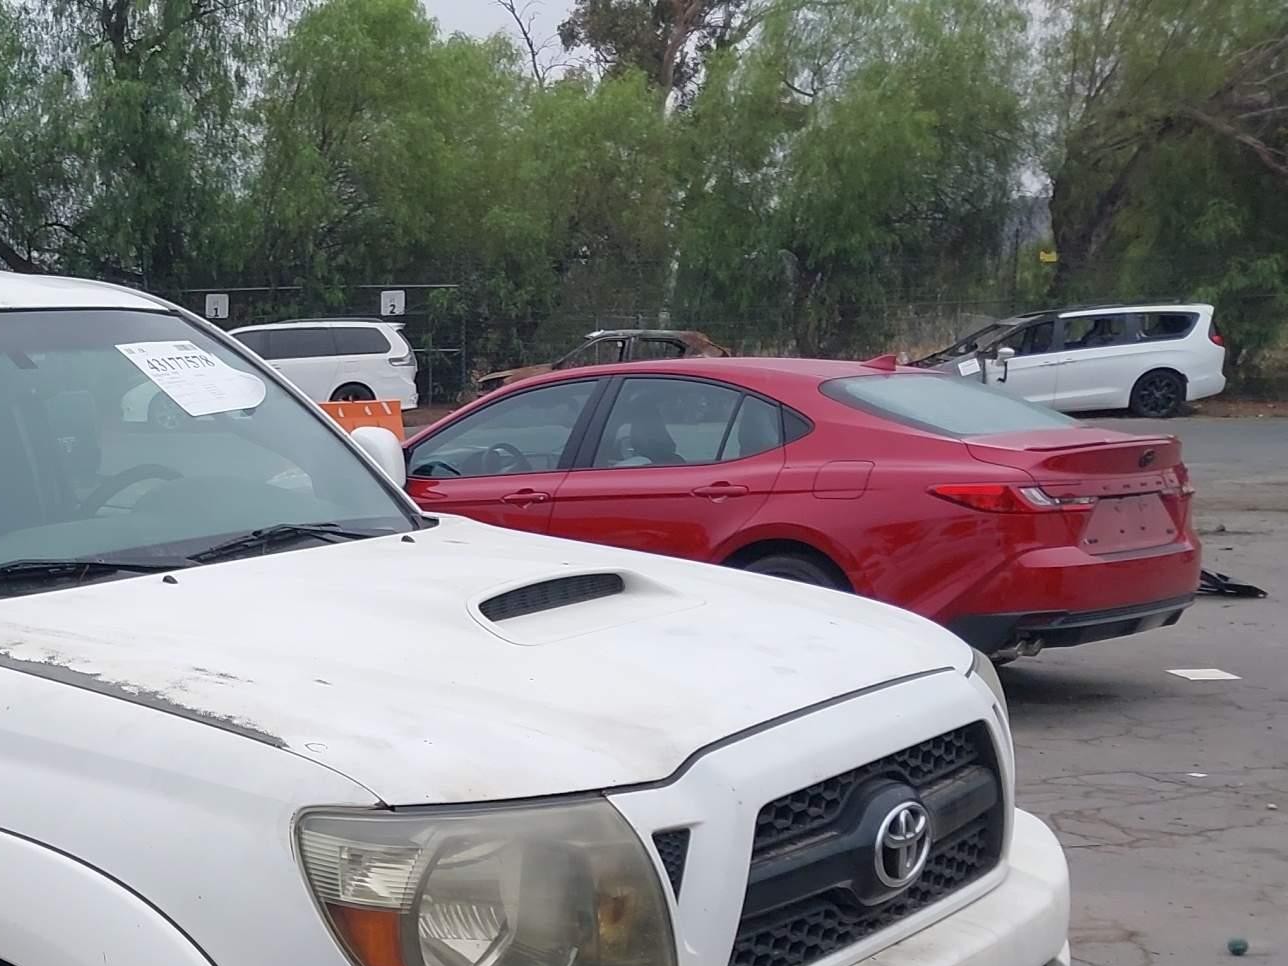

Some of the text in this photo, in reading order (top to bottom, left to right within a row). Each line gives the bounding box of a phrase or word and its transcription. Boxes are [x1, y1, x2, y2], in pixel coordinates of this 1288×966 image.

[214, 306, 219, 317] 1
[389, 303, 396, 315] 2
[146, 355, 215, 372] 43177578
